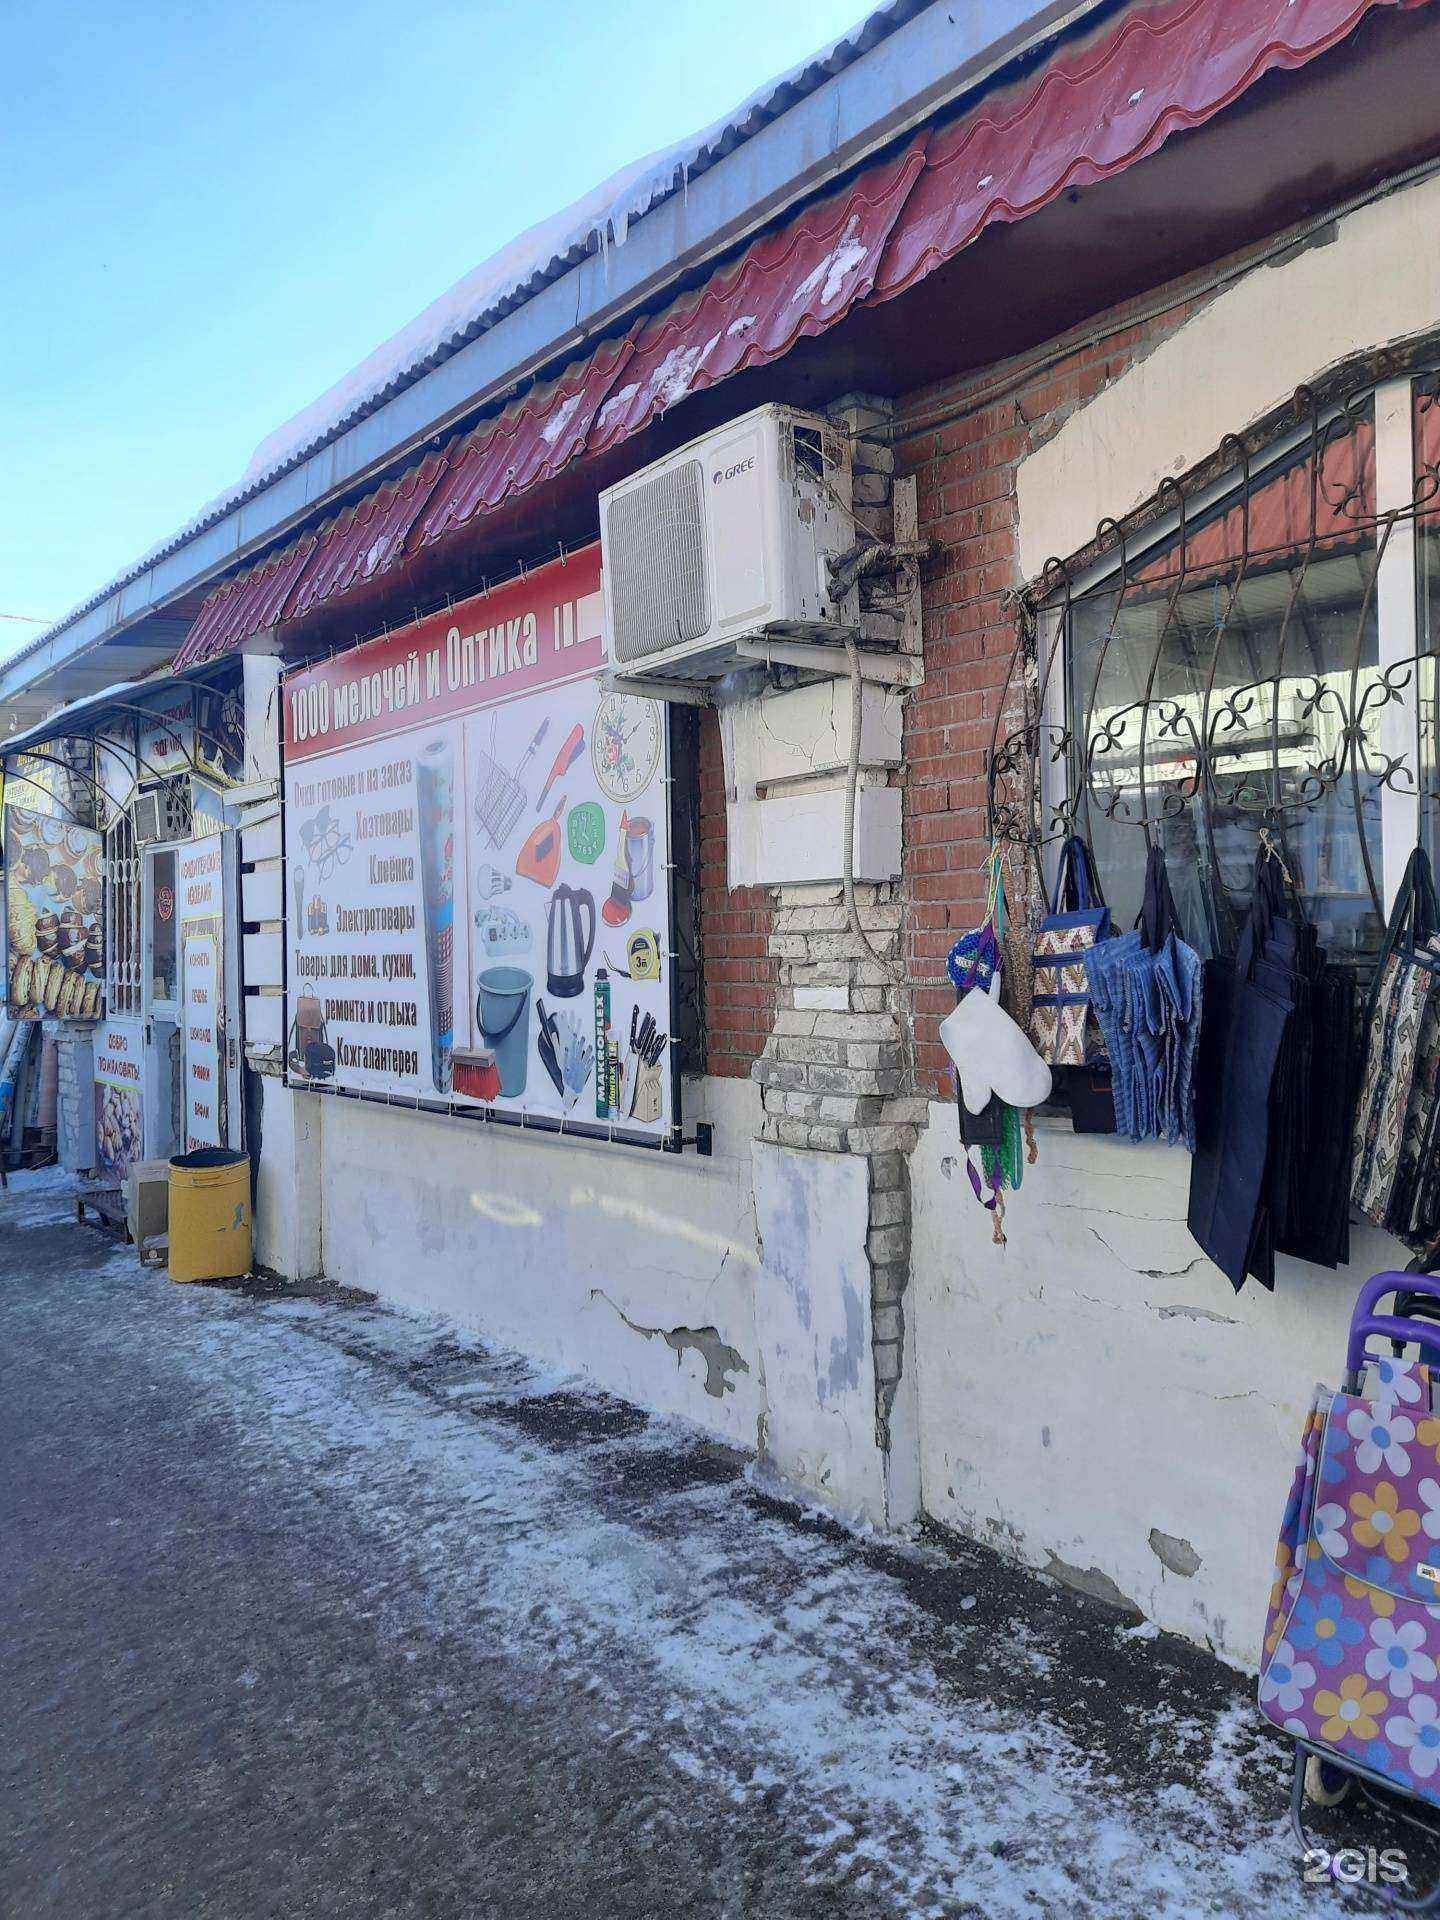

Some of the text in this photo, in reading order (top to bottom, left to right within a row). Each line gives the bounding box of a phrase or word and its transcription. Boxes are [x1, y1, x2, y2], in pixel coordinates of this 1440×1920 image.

[725, 456, 755, 480] GREE
[291, 612, 538, 744] 1000 мелочей и Оптика
[294, 760, 413, 808] Очки готовые и на заказ
[355, 808, 414, 841] Хозтовары
[336, 904, 416, 936] Электротовары
[295, 949, 417, 982] Товары для дома, кухни,
[325, 998, 417, 1027] ремонта и отдыха
[336, 1036, 418, 1078] Кожгалантерея
[596, 994, 606, 1103] MAKROFLEX
